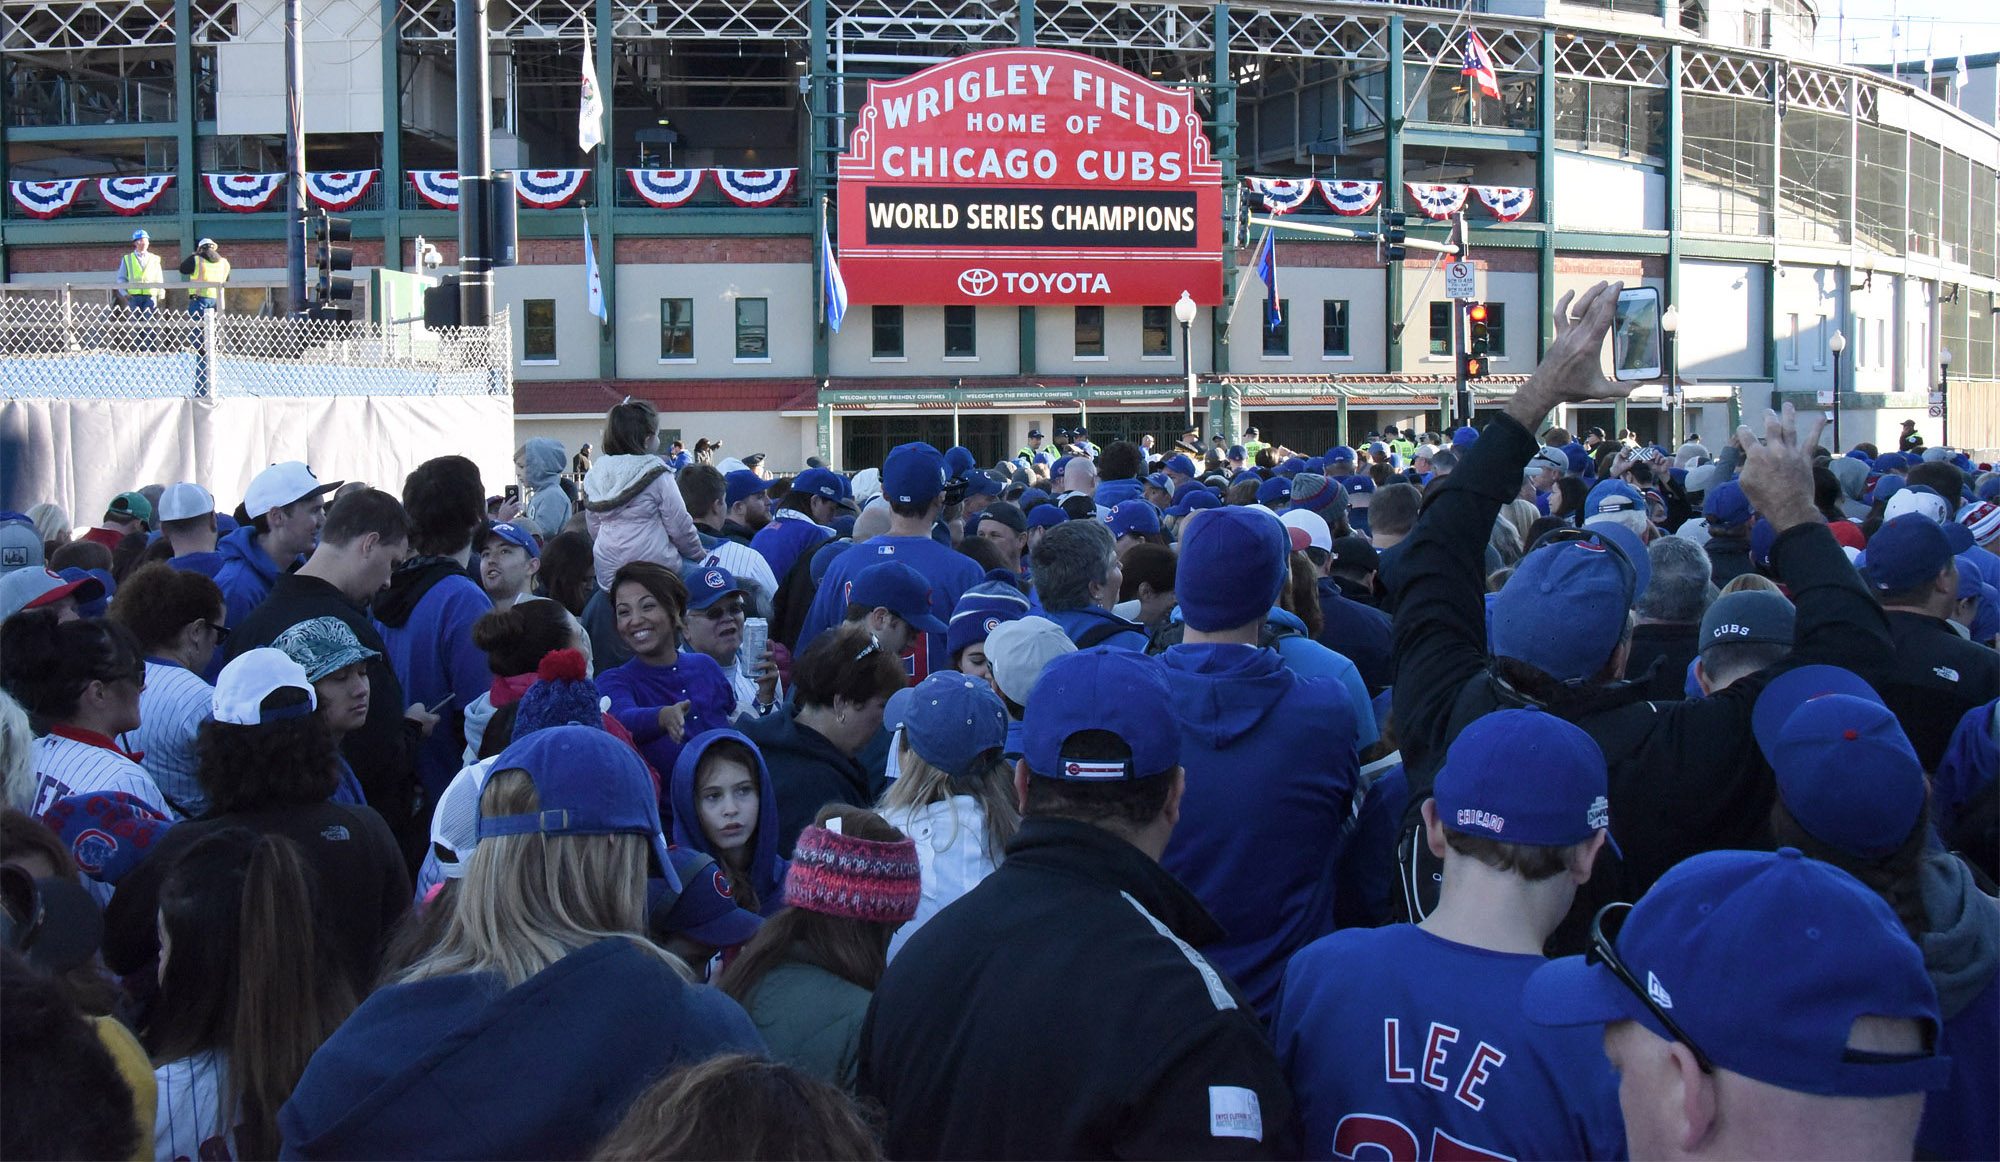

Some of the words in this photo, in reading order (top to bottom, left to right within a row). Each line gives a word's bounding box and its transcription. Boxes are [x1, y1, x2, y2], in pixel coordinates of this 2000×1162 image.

[882, 64, 1055, 130] WRIGLEY
[1073, 69, 1180, 135] FIELD
[967, 112, 1046, 133] HOME
[1066, 115, 1101, 134] OF
[882, 145, 1057, 179] CHICAGO
[1077, 150, 1181, 181] CUBS
[869, 202, 959, 229] WORLD
[967, 203, 1043, 230] SERIES
[1052, 205, 1195, 232] CHAMPIONS
[1002, 272, 1111, 294] TOYOTA
[1713, 624, 1750, 638] CUBS
[1457, 809, 1504, 833] CHICAGO
[1384, 1018, 1507, 1112] LEE
